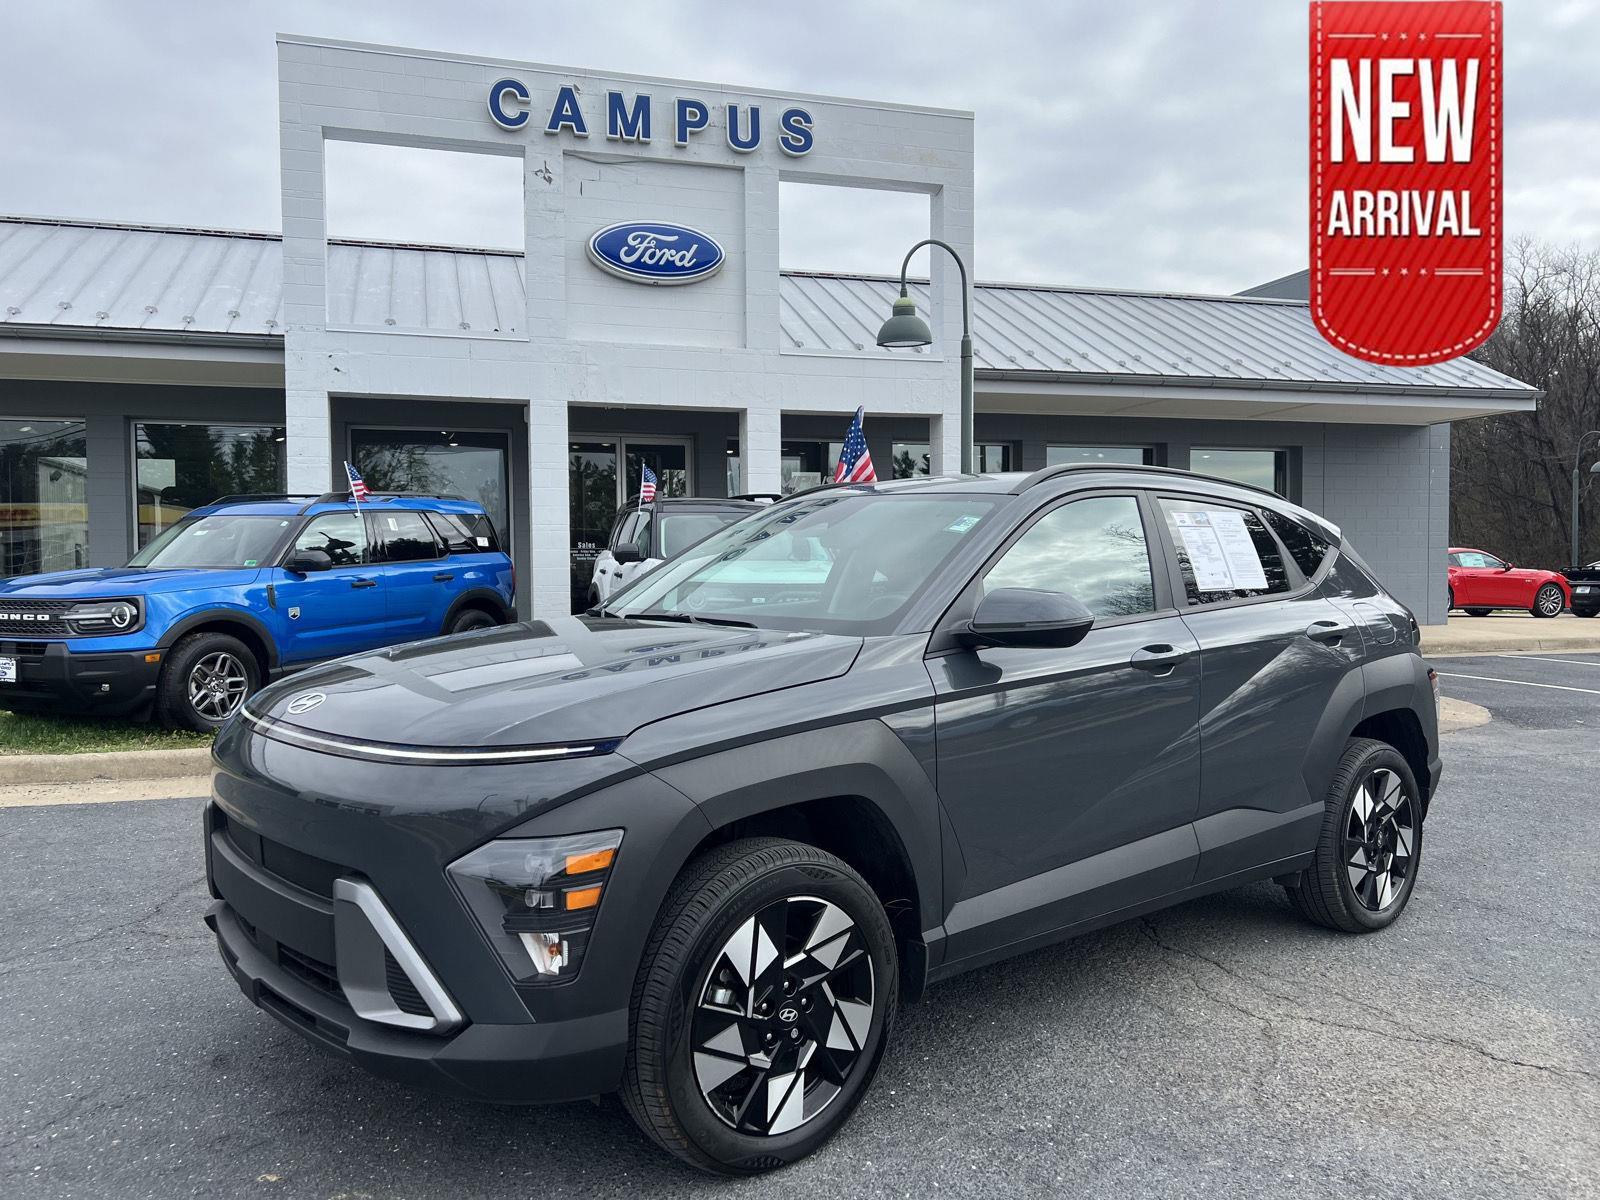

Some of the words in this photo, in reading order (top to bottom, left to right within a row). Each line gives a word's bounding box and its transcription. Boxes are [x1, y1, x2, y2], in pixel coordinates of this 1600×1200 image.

[487, 77, 815, 157] CAMPUS
[619, 231, 698, 269] Ford
[577, 541, 596, 549] Sales
